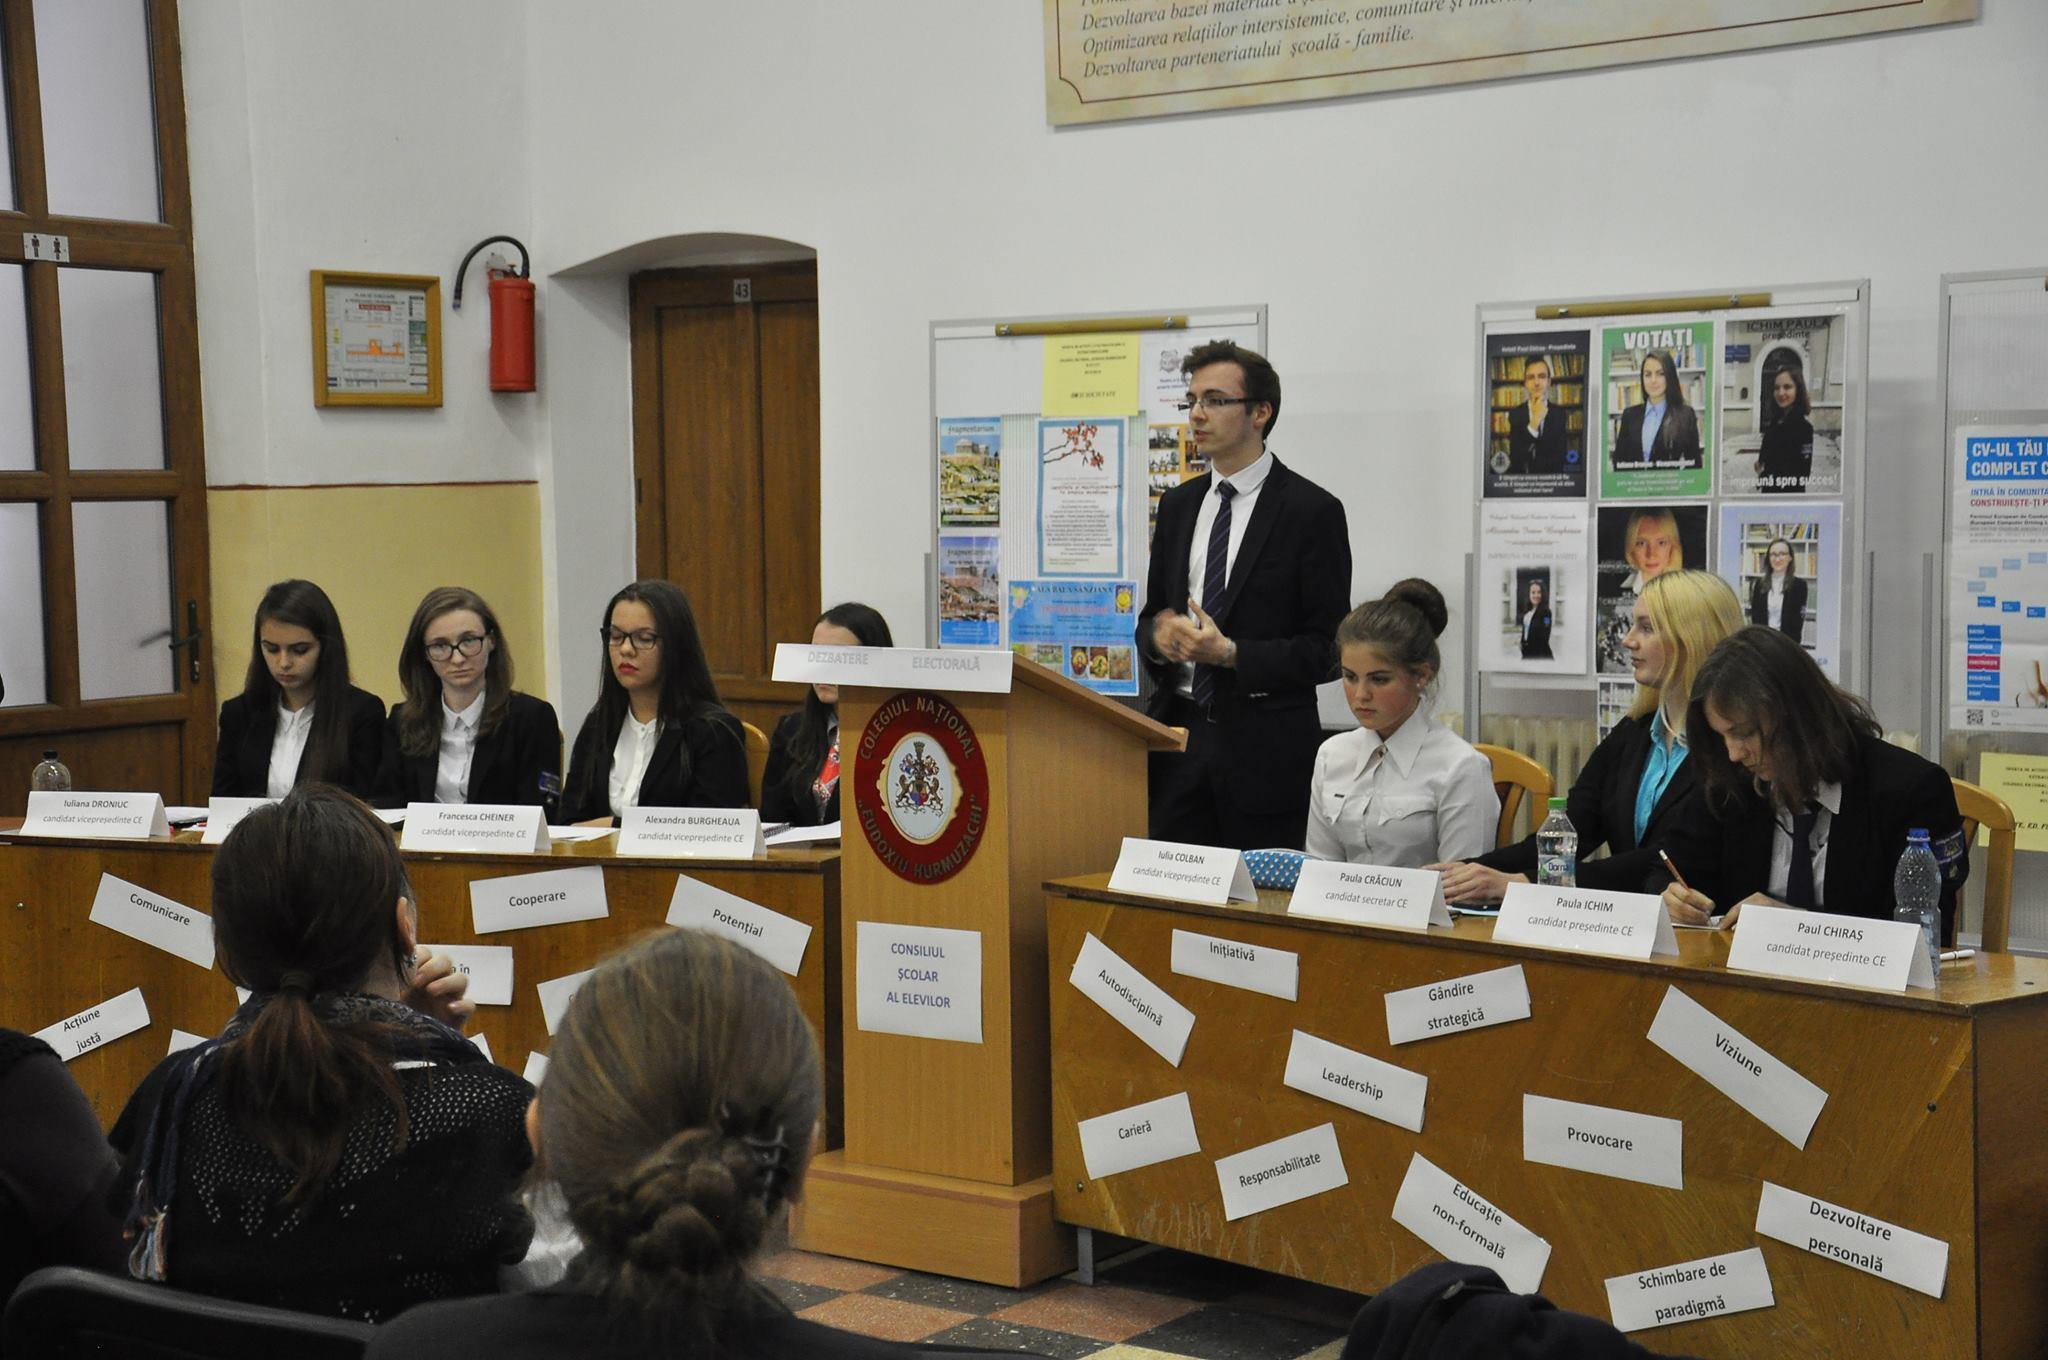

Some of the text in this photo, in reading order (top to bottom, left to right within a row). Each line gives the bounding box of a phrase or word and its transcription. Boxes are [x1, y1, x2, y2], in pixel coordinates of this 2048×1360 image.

[1082, 10, 1166, 31] Dezvoltarea
[1170, 3, 1208, 20] bazei
[1083, 31, 1168, 58] Optimizarea
[1242, 10, 1350, 36] intersistemice,
[1083, 55, 1167, 78] Dezvoltarea
[1171, 43, 1282, 74] parteneriatului
[1354, 24, 1414, 50] familie.
[736, 283, 748, 298] 43
[1747, 318, 1830, 332] ICHIM PAULA
[1972, 438, 2043, 457] CV-UL TĂU
[1972, 461, 2037, 476] COMPLET
[1776, 476, 1797, 488] spre
[807, 651, 981, 672] DEZBATERE ELECTORALĂ
[860, 698, 910, 760] COLEGIUL
[64, 800, 128, 808] Iuliana DRONIUC
[43, 814, 75, 823] candidat
[133, 816, 143, 825] CE
[438, 811, 515, 822] Francesca CHEINER
[645, 815, 741, 826] Alexandra BURGHEAUA
[422, 827, 455, 837] candidat
[516, 830, 527, 839] CE
[638, 833, 671, 842] candidat
[733, 835, 744, 844] CE
[1158, 850, 1205, 864] Iulia COLBAN
[1133, 866, 1163, 878] candidat
[1211, 876, 1222, 886] CE
[1340, 872, 1403, 888] Paula CRĂCIUN
[509, 890, 567, 907] Cooperare
[1325, 891, 1408, 909] candidat secretar CE
[1556, 897, 1613, 912] Paula ICHIM
[130, 893, 190, 926] Comunicare
[1528, 915, 1567, 928] candidat
[1621, 926, 1634, 937] CE
[1797, 922, 1820, 935] Paul
[891, 943, 945, 959] CONSILIUL
[1766, 942, 1810, 956] candidat
[1872, 954, 1886, 967] CE
[886, 991, 951, 1009] AL ELEVILOR
[1098, 968, 1163, 1027] Autodisciplină
[1428, 983, 1474, 1002] Gândire
[1428, 1008, 1485, 1030] strategică
[76, 1032, 102, 1053] justă
[1715, 1033, 1763, 1077] Viziune
[1322, 1067, 1383, 1101] Leadership
[1118, 1119, 1152, 1140] Carieră
[1567, 1127, 1633, 1151] Provocare
[1239, 1151, 1322, 1188] Responsabilitate
[1809, 1200, 1892, 1241] Dezvoltare
[1432, 1203, 1506, 1260] non-formală
[1809, 1236, 1884, 1274] personală
[1638, 1262, 1727, 1290] Schimbare de
[1655, 1295, 1726, 1323] paradigmă
